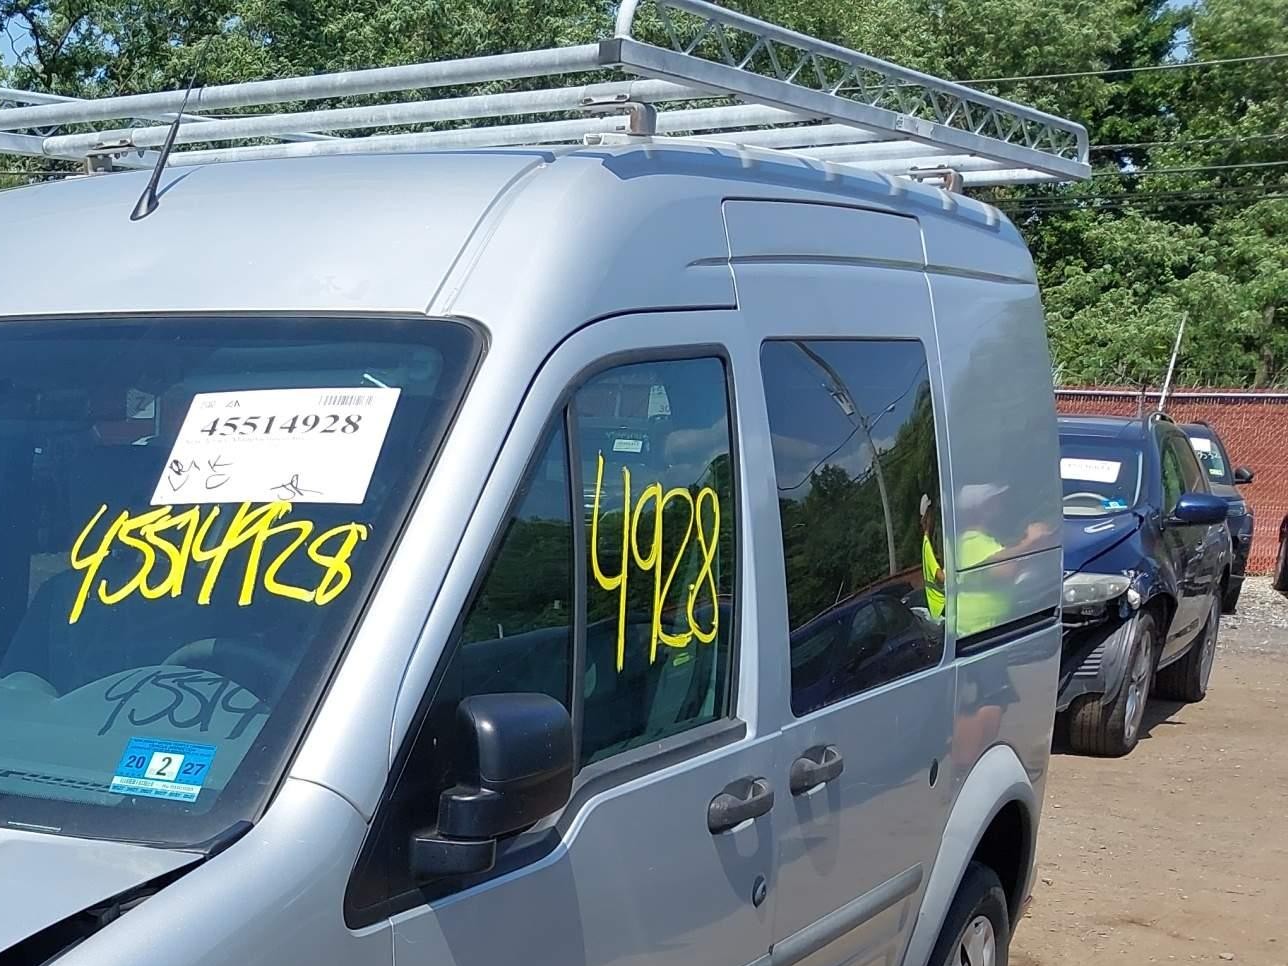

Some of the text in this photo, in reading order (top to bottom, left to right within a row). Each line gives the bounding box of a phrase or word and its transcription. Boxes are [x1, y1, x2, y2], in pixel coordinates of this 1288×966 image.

[200, 413, 363, 437] 45514928
[68, 501, 368, 624] 45514928
[591, 449, 721, 673] 4928
[125, 754, 206, 777] 20 2 27
